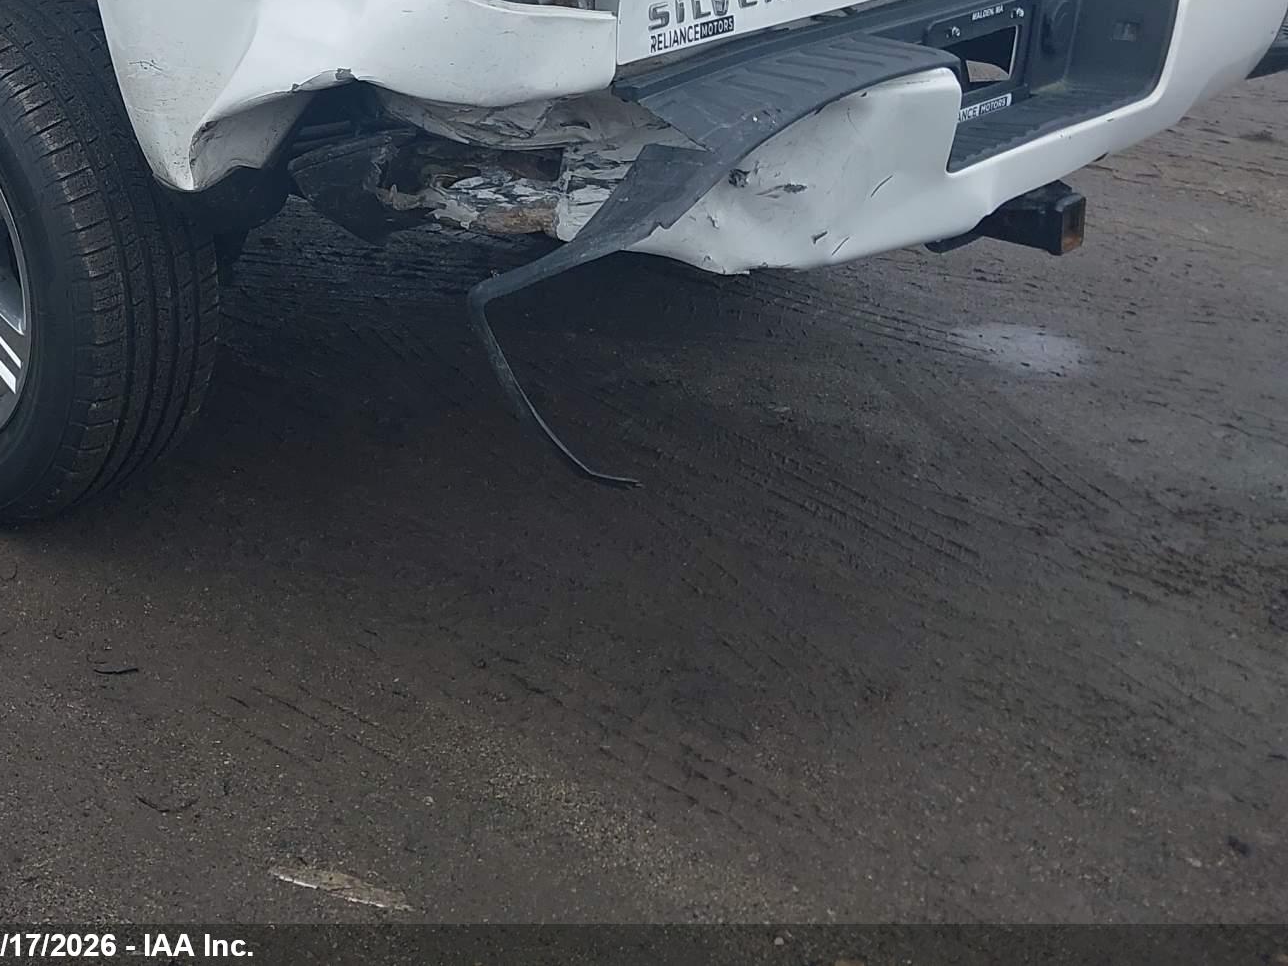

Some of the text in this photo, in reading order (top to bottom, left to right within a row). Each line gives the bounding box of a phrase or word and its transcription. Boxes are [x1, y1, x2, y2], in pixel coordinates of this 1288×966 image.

[650, 17, 734, 53] RELIANCE MOTORS
[958, 98, 1006, 122] ANCE MOTORS
